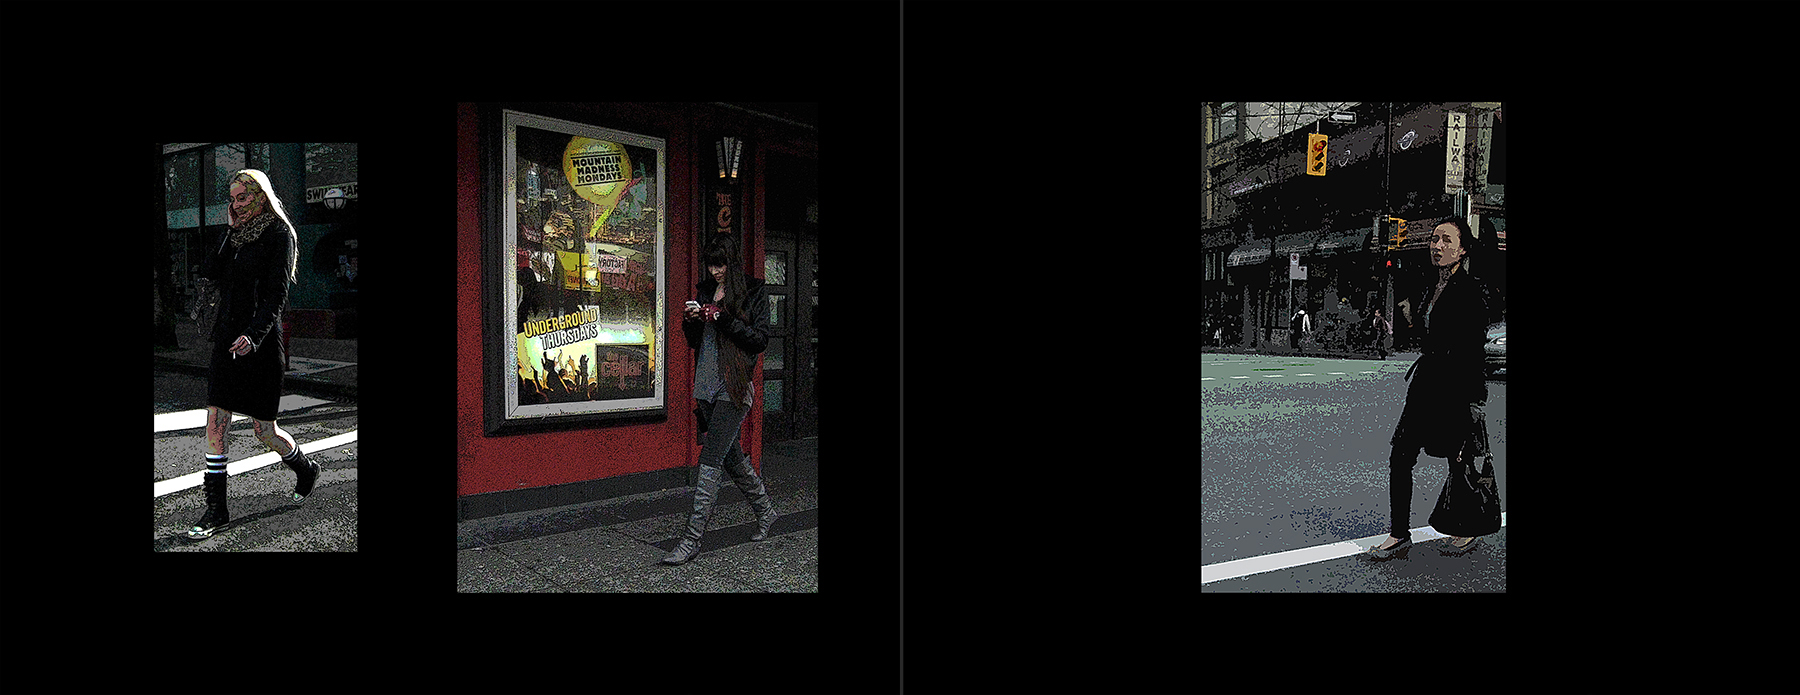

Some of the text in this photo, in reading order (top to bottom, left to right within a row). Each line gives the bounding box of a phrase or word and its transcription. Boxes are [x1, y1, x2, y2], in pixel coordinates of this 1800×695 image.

[1451, 115, 1461, 167] RAILWA
[572, 156, 622, 168] MOUNTAIN
[577, 164, 620, 175] MADNESS
[578, 172, 622, 183] MONDAYS
[523, 308, 599, 339] UNDERGROUND
[540, 324, 599, 350] THURSDAYS
